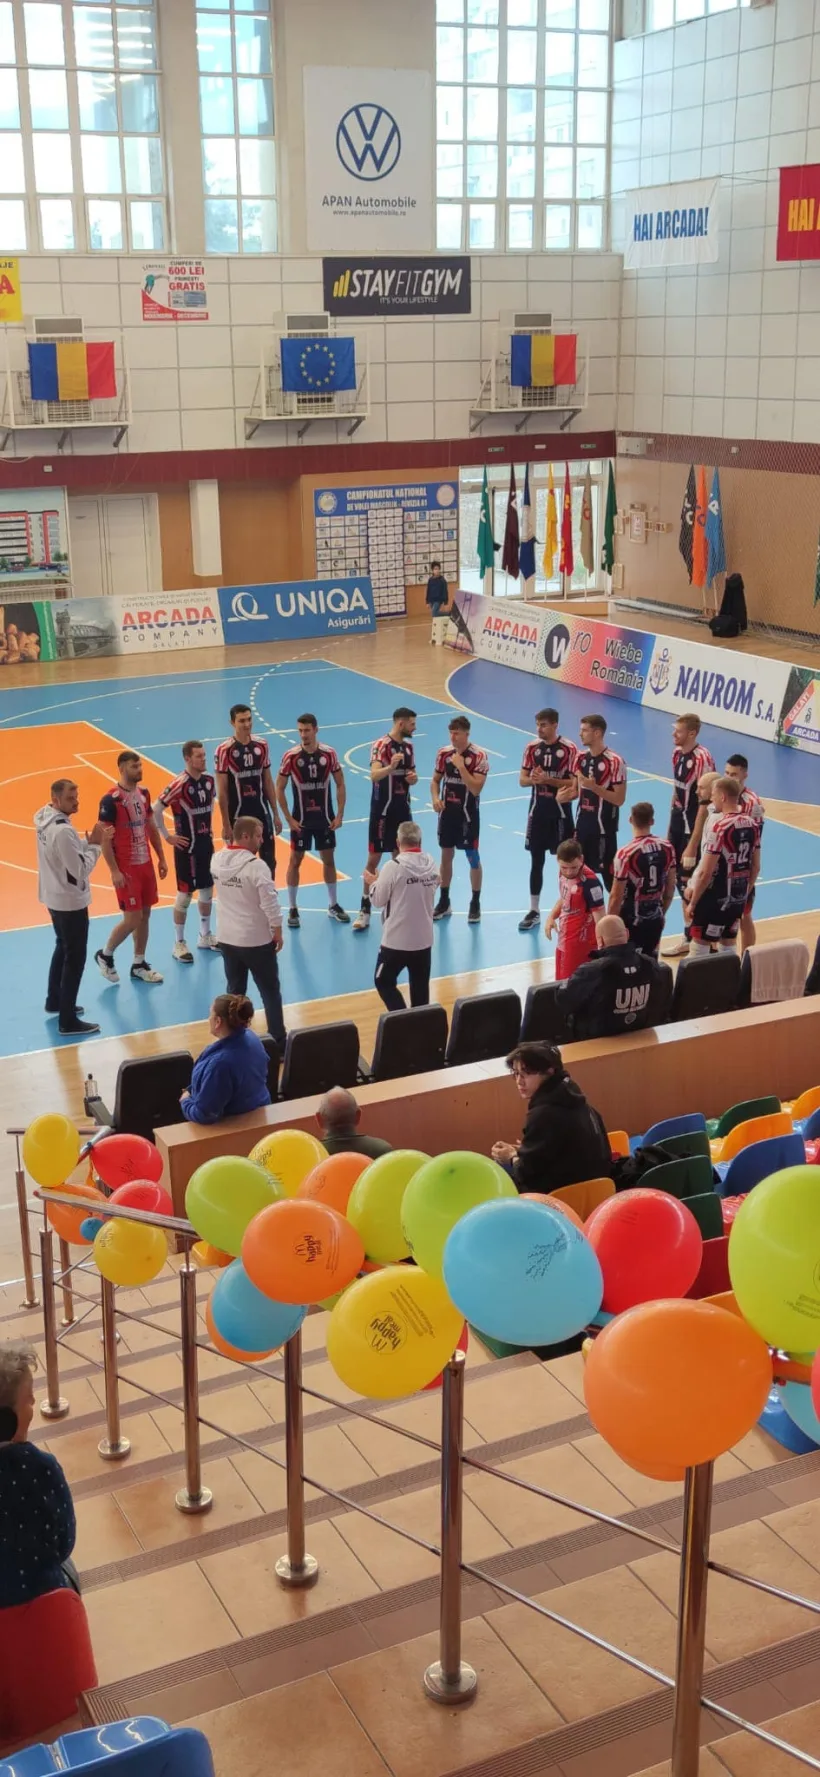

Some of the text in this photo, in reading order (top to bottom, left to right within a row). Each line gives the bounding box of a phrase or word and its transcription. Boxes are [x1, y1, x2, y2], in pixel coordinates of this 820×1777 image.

[322, 195, 416, 208] APAN Automobile
[333, 209, 406, 217] www.apanautomobile.ro
[788, 198, 815, 232] HAI
[633, 206, 709, 242] HAI ARCADA!
[168, 266, 186, 275] 600
[189, 266, 204, 275] LEI
[169, 282, 205, 290] GRATIS
[347, 489, 394, 500] CAMPIONATUL
[275, 587, 369, 618] UNIQA
[122, 606, 217, 631] ARCADA
[327, 614, 371, 630] Asigurări
[123, 627, 218, 643] COMPANY
[482, 616, 538, 648] ARCADA
[480, 638, 536, 660] COMPANY
[605, 638, 643, 665] Wiebe
[590, 659, 645, 691] România
[674, 665, 757, 716] NAVROM
[755, 699, 776, 723] S.A.
[793, 727, 820, 741] ARCADA
[243, 753, 254, 767] 20
[544, 754, 552, 767] 11
[308, 764, 317, 778] 13
[134, 802, 142, 815] 15
[649, 865, 658, 887] 9
[615, 984, 651, 1009] UNI
[370, 1318, 402, 1351] happy
